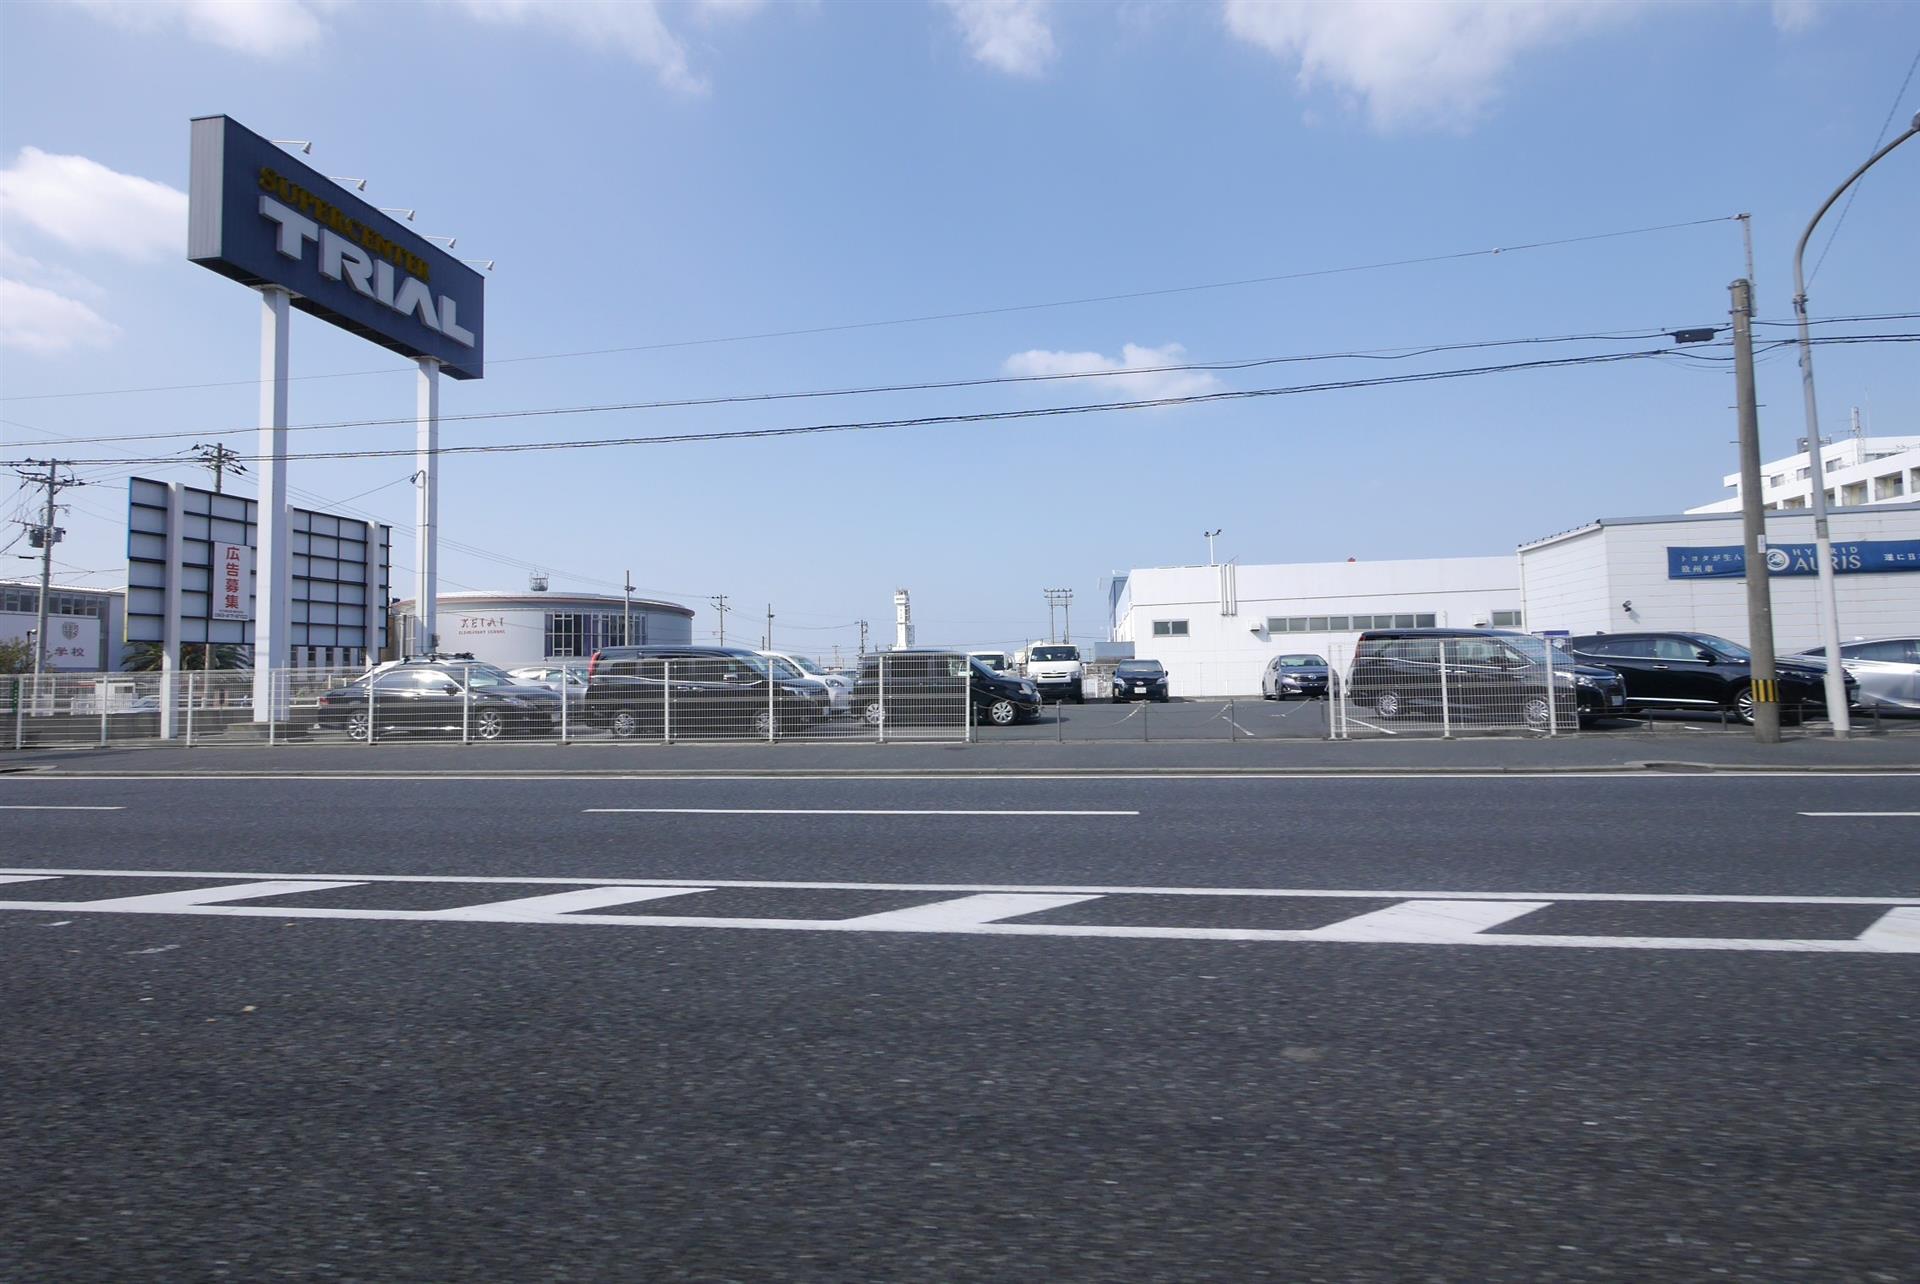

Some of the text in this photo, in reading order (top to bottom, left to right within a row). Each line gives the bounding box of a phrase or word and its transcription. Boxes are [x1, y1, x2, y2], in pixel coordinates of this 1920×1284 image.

[259, 195, 475, 348] TRIAL
[225, 546, 240, 609] 広告募集
[1792, 546, 1858, 556] HYRID
